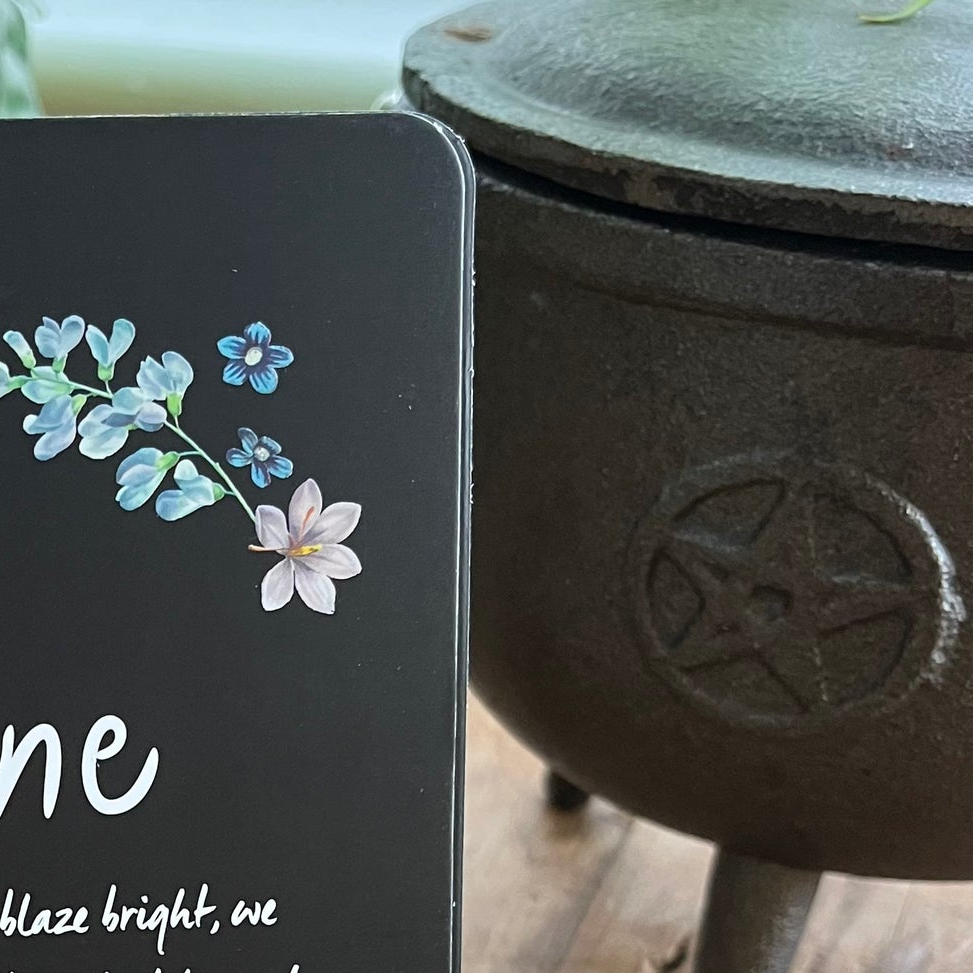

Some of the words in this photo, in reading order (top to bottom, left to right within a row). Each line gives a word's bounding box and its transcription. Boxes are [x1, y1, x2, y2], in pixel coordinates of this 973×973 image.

[0, 889, 89, 936] blaze
[102, 884, 220, 955] bright,
[231, 898, 277, 926] we
